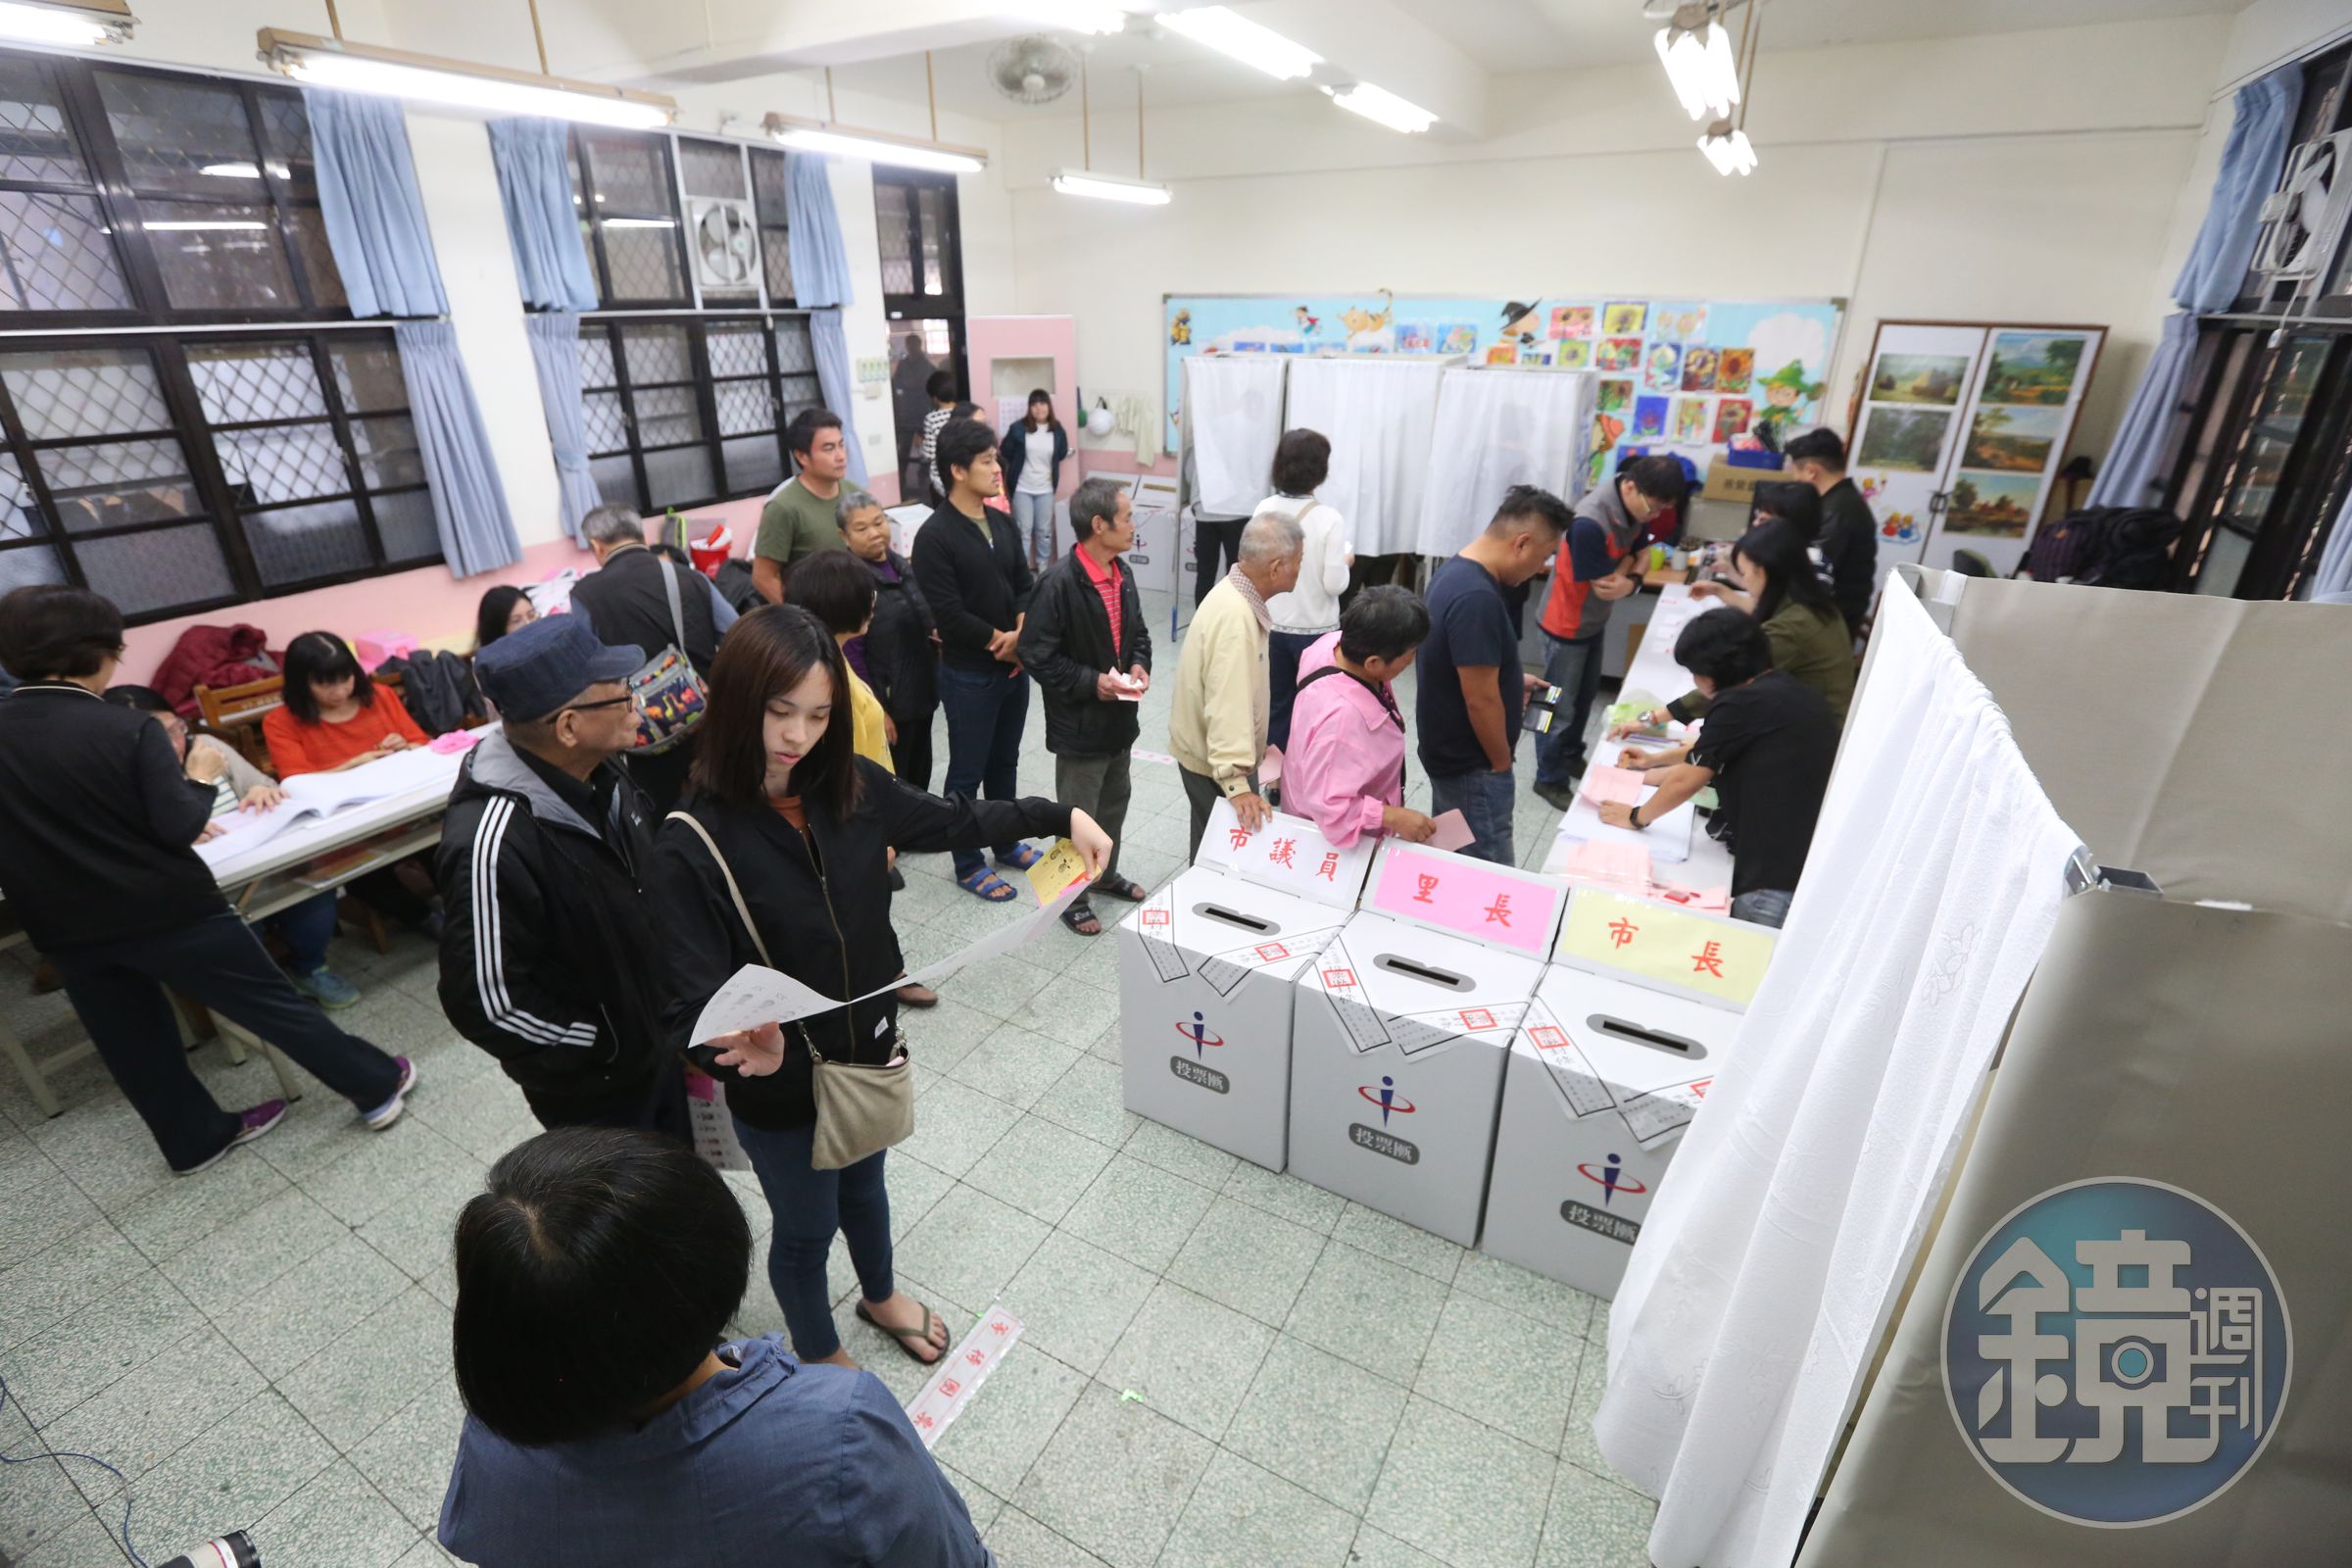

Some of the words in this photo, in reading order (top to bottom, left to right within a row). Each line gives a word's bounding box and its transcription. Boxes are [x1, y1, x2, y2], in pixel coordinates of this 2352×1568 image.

[1228, 826, 1340, 882] 市議員
[1412, 873, 1513, 928] 里長
[1607, 916, 1725, 978] 市長
